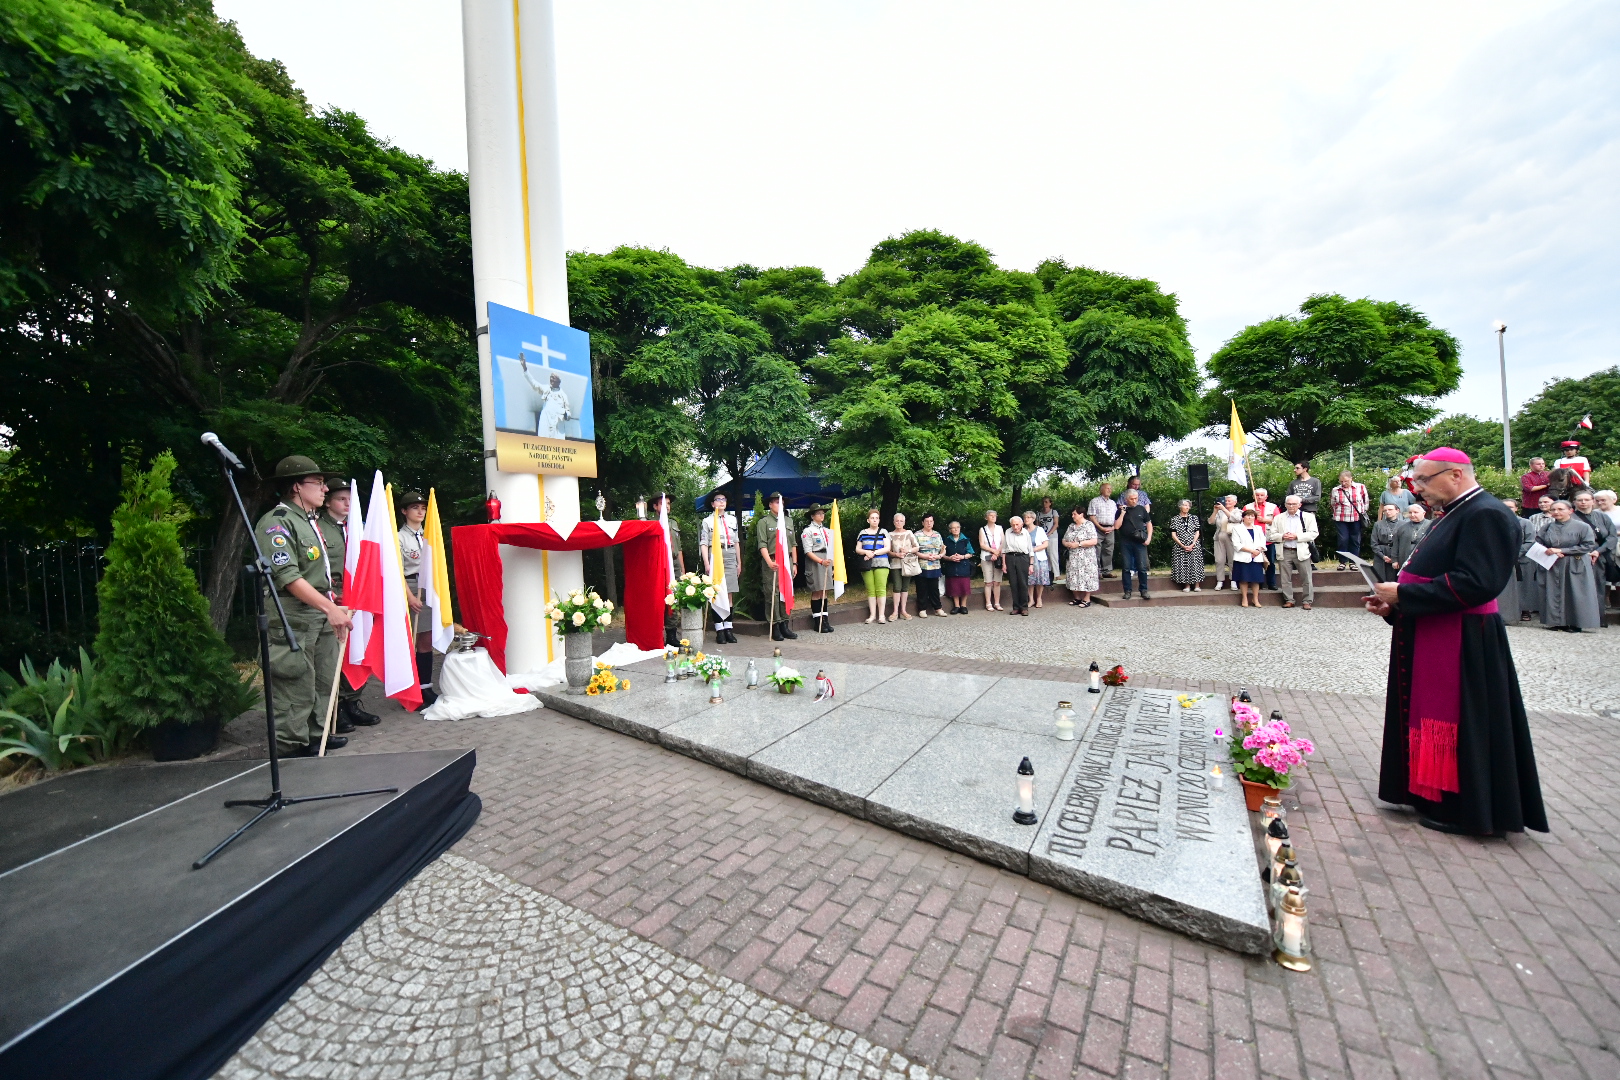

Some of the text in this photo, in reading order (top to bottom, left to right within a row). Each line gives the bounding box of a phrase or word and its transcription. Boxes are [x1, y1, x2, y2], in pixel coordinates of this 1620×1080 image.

[531, 443, 552, 452] ZACZĘŁY
[553, 446, 561, 454] SIĘ
[1180, 710, 1206, 729] 1983
[1176, 729, 1209, 771] CZERWCA
[1104, 692, 1172, 858] PAPIEŻ JAN PAWEŁ II
[1175, 771, 1208, 789] 20
[1056, 757, 1112, 834] CELEBROWAŁ
[1175, 788, 1213, 825] DNIU
[1174, 822, 1213, 843] W
[1045, 833, 1087, 859] TU
